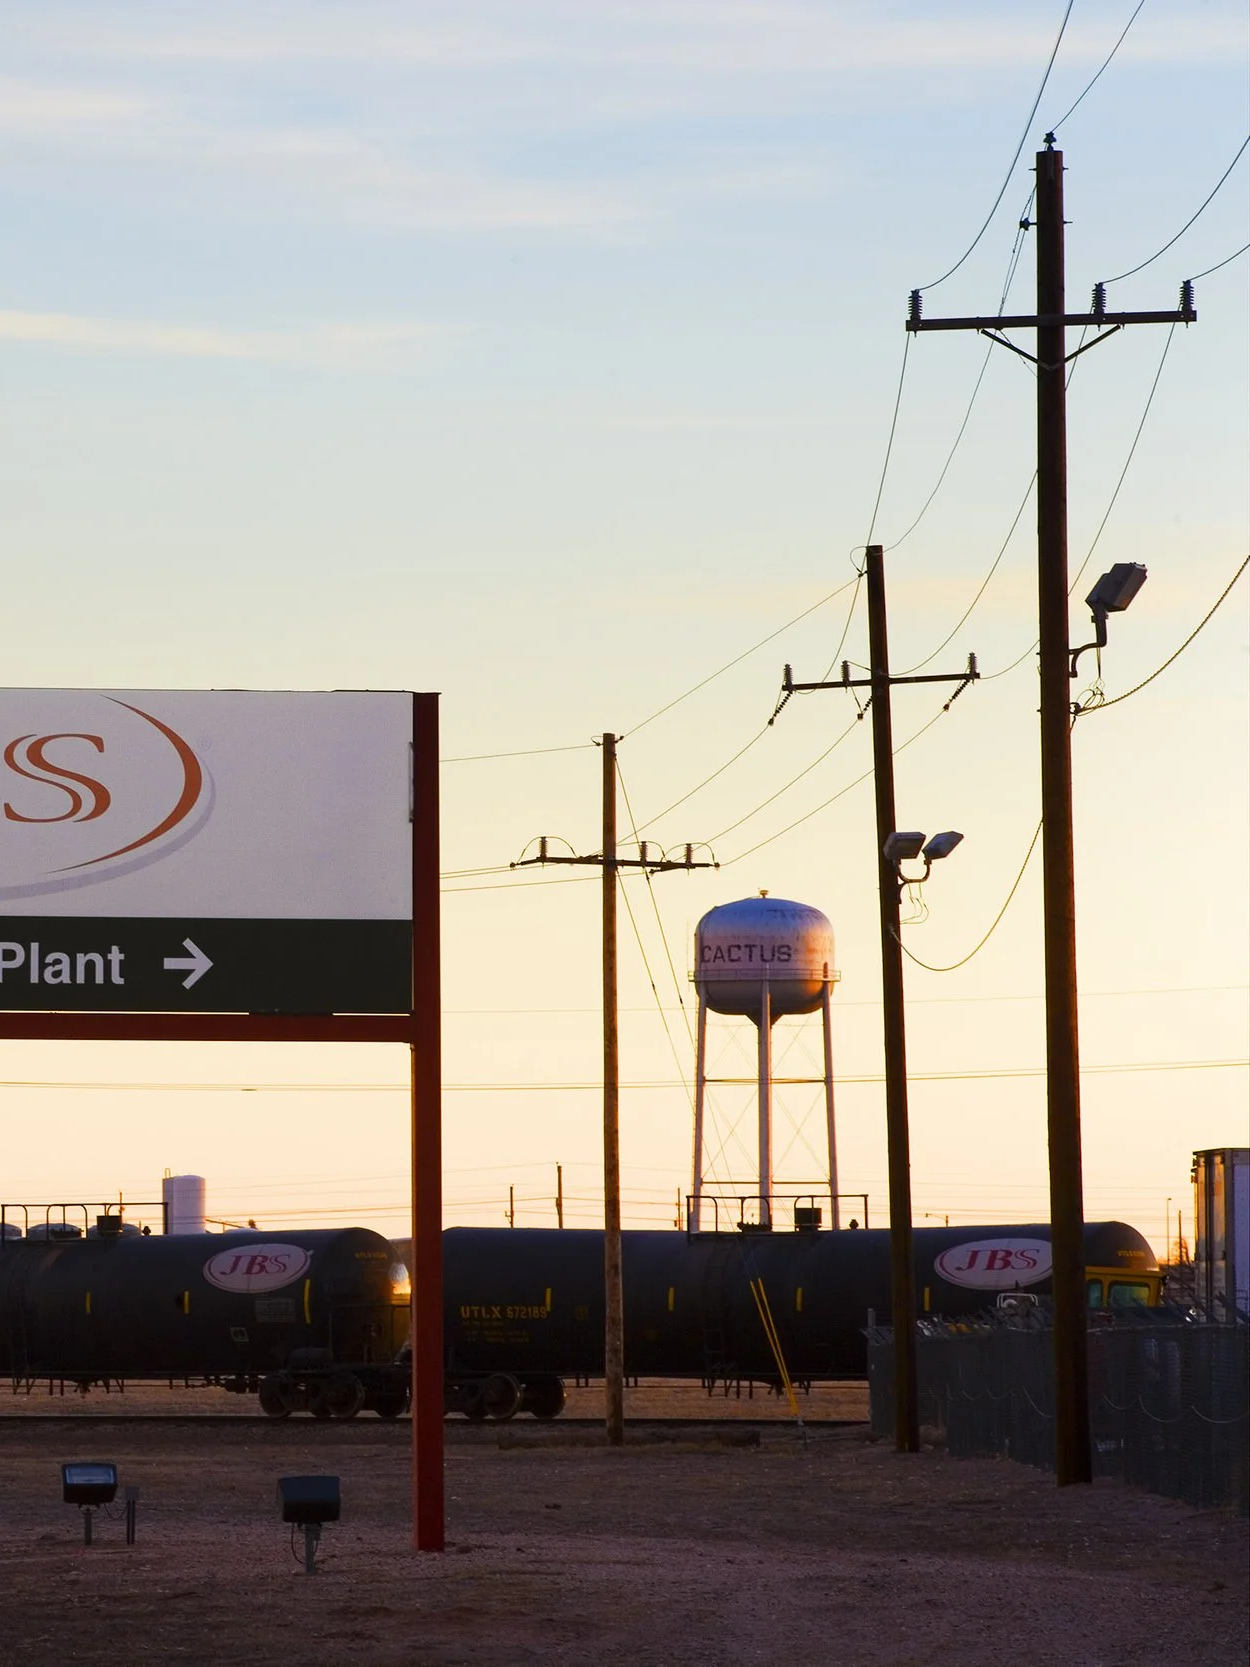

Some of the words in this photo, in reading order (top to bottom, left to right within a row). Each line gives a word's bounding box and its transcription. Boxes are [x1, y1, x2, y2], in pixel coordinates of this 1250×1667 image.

[701, 944, 793, 964] CACTUS
[219, 1254, 291, 1276] JBS
[955, 1248, 1040, 1272] JBS
[461, 1305, 502, 1320] UTLX
